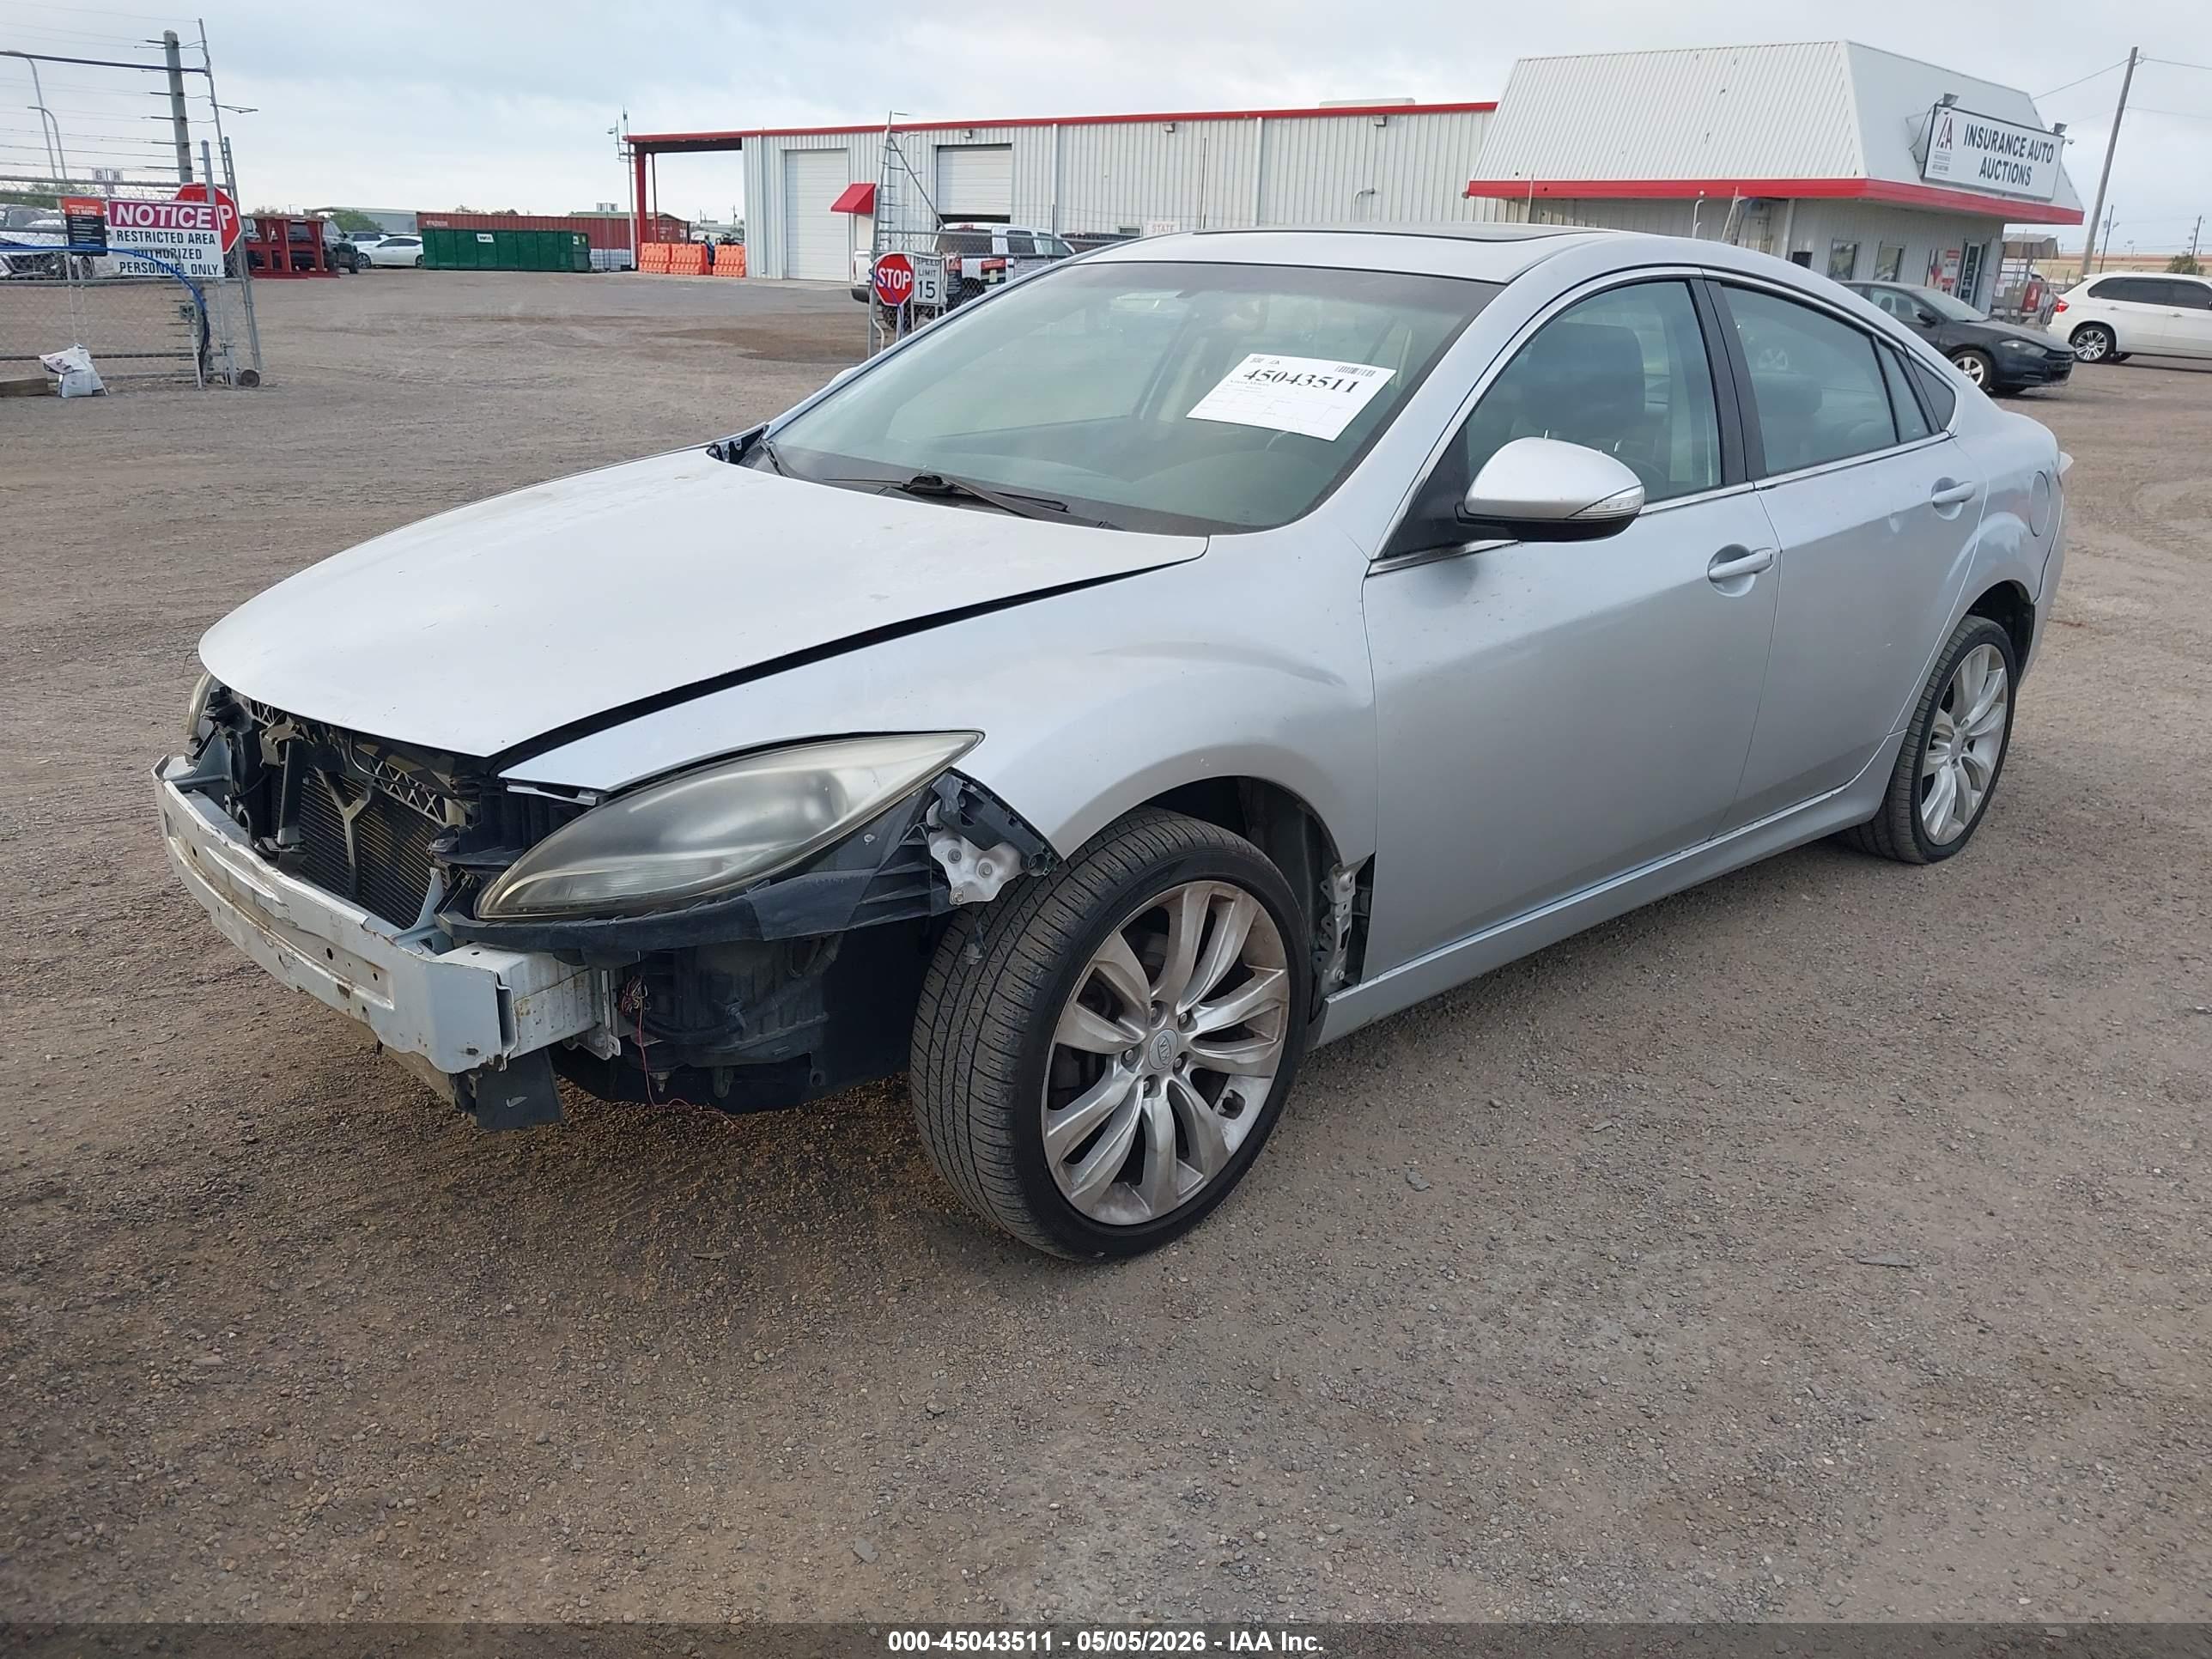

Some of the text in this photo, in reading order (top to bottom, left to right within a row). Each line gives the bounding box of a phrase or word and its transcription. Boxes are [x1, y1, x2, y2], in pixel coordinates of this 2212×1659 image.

[1963, 123, 2054, 164] INSURANCE AUTO
[1978, 156, 2033, 186] AUCTIONS
[115, 204, 212, 228] NOTICE
[117, 230, 184, 244] RESTRICTED
[188, 233, 216, 245] AREA
[119, 261, 219, 276] PERSONNEL ONLY
[916, 257, 939, 266] SPEED
[877, 267, 912, 290] STOP
[919, 280, 936, 299] 15
[1243, 368, 1359, 393] 45043511
